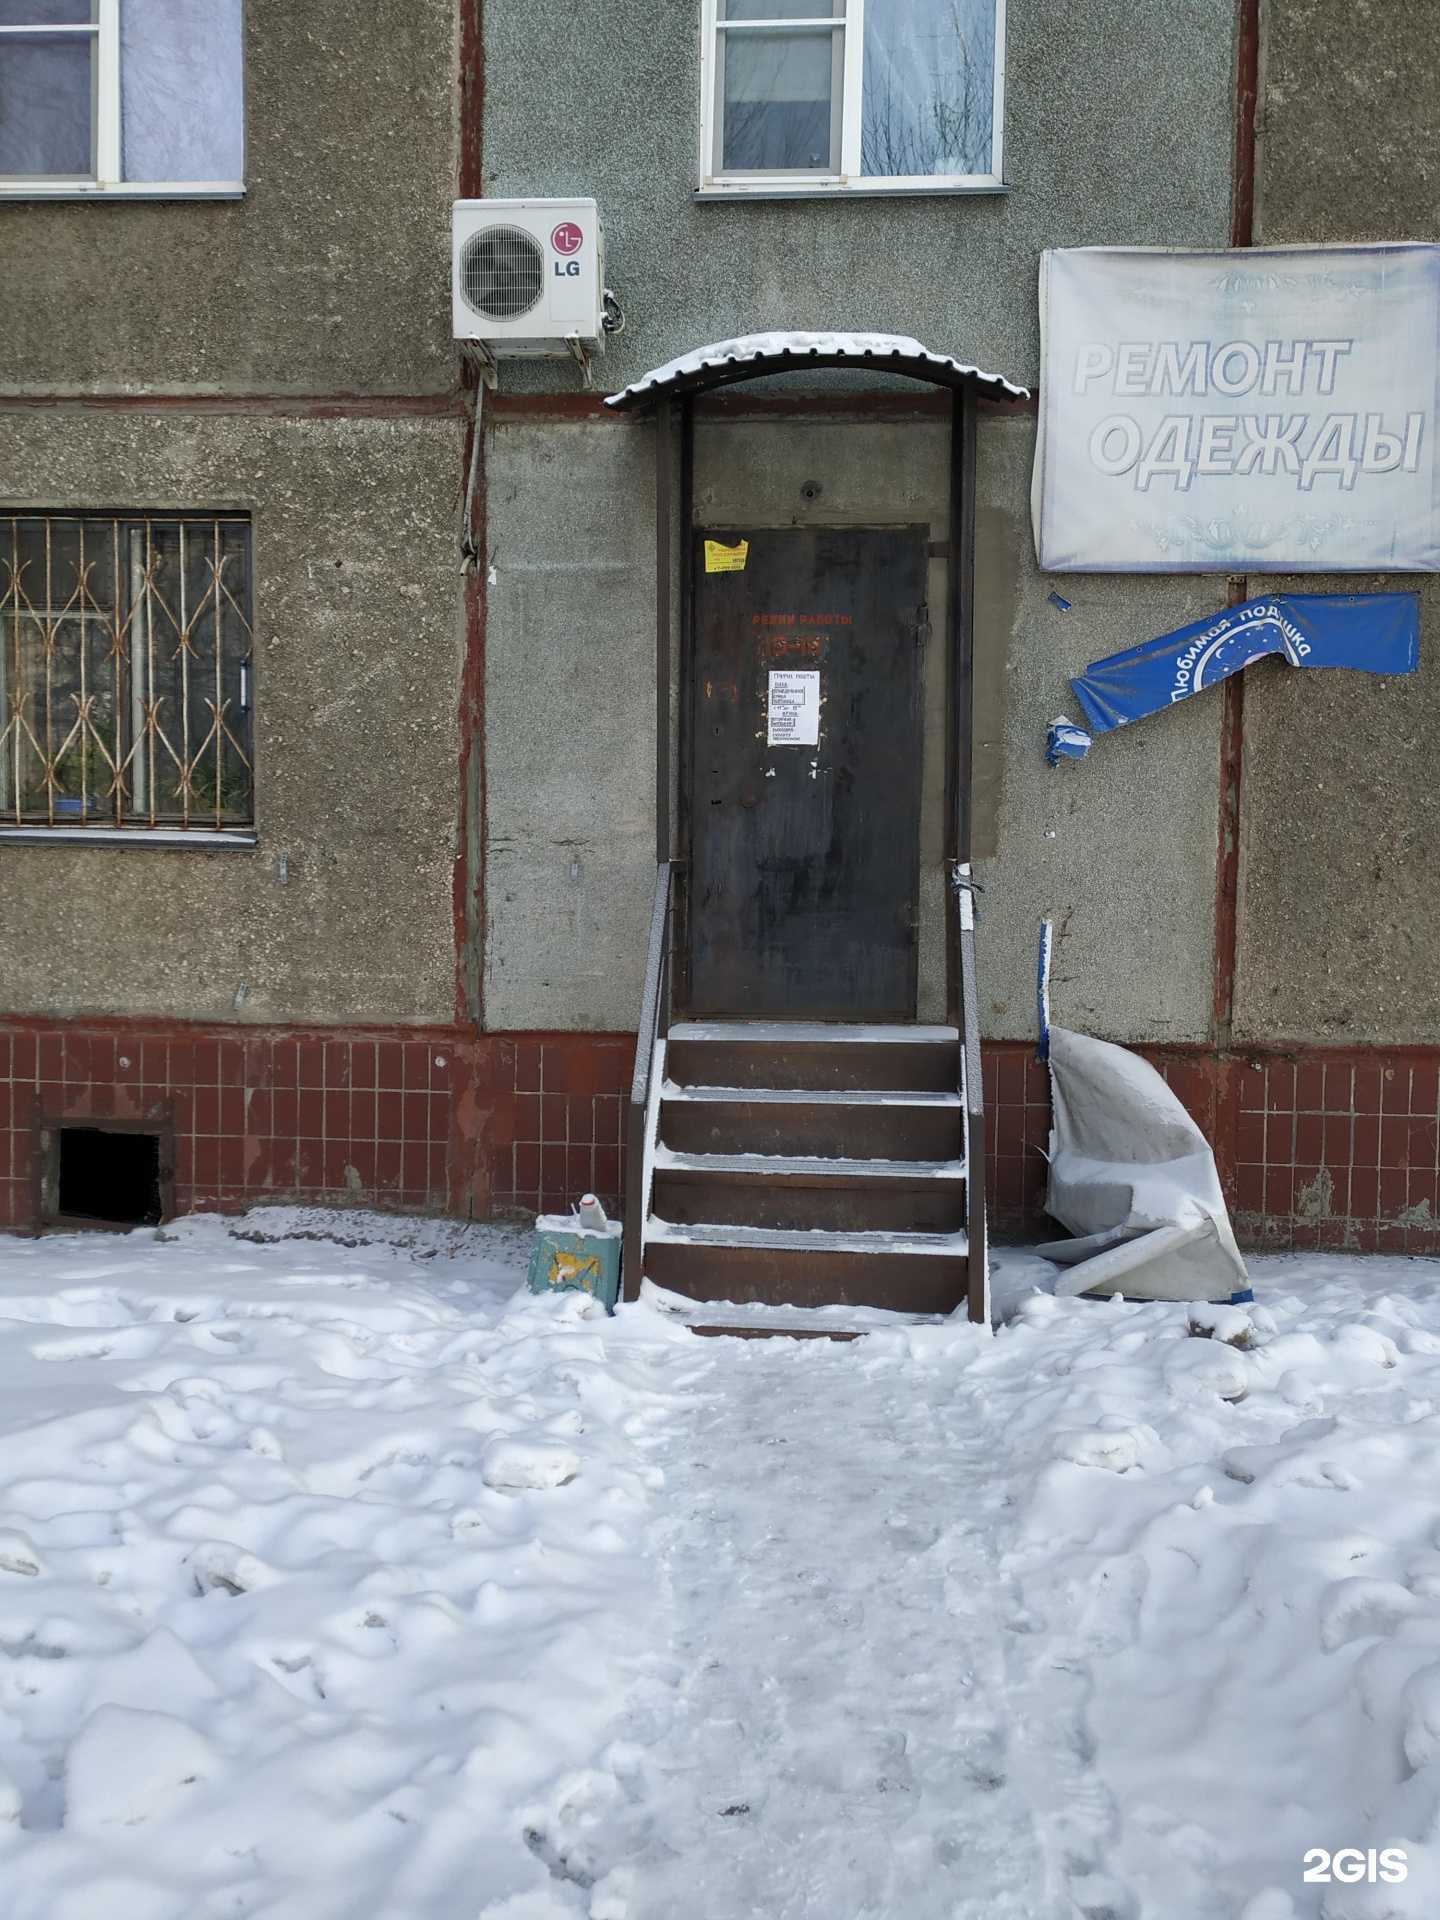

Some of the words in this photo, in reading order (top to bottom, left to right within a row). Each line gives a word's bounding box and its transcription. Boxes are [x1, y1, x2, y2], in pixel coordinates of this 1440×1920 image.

[554, 260, 580, 277] LG
[1072, 339, 1353, 398] РЕМОНТ
[1088, 411, 1427, 492] ОДЕЖДЫ
